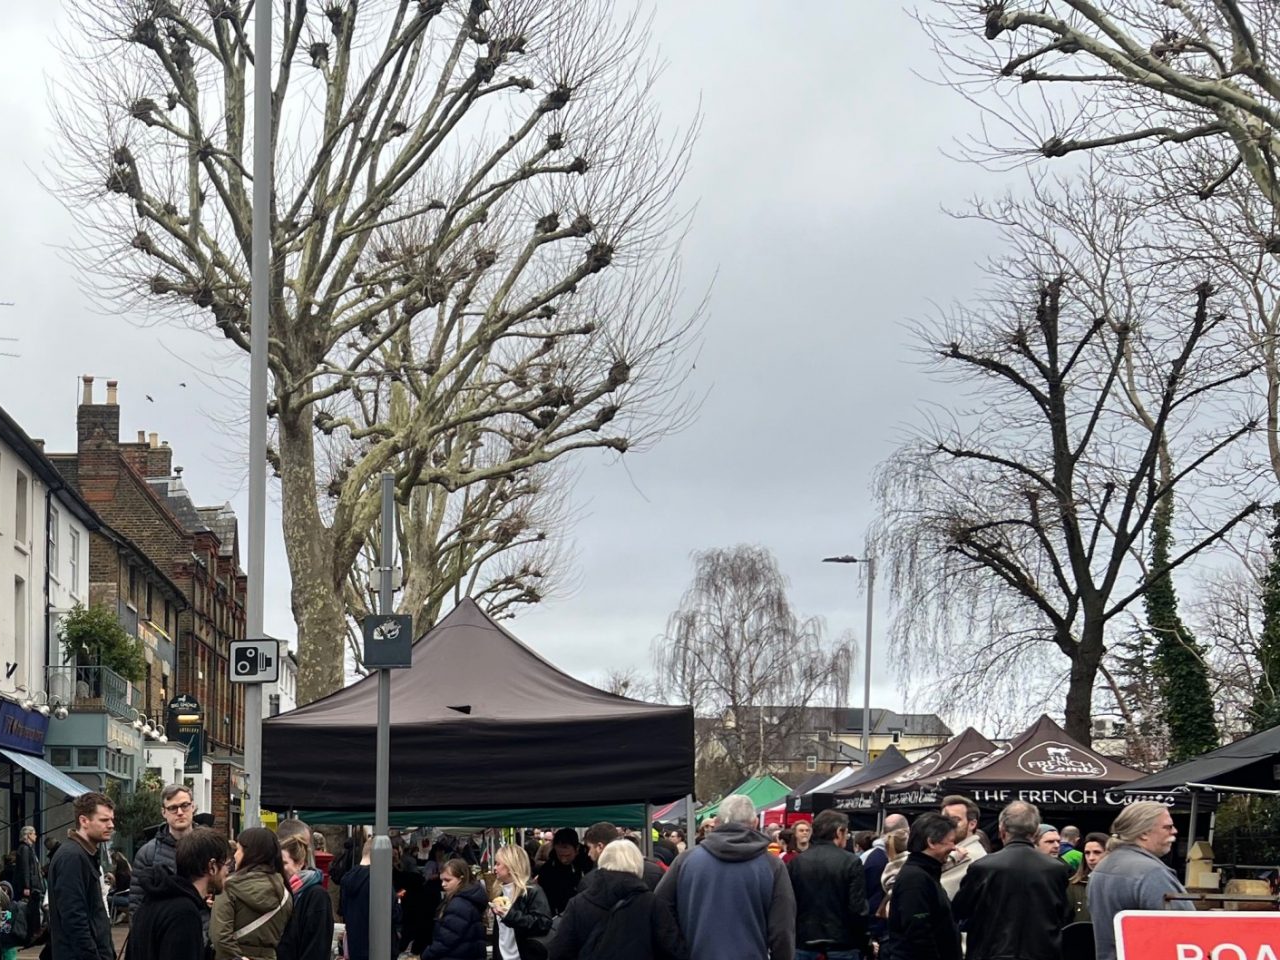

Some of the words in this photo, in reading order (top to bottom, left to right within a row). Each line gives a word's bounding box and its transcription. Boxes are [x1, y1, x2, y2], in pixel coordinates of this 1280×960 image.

[1027, 760, 1094, 770] FRENCH
[970, 790, 1011, 802] THE
[1019, 789, 1097, 804] FRENCH
